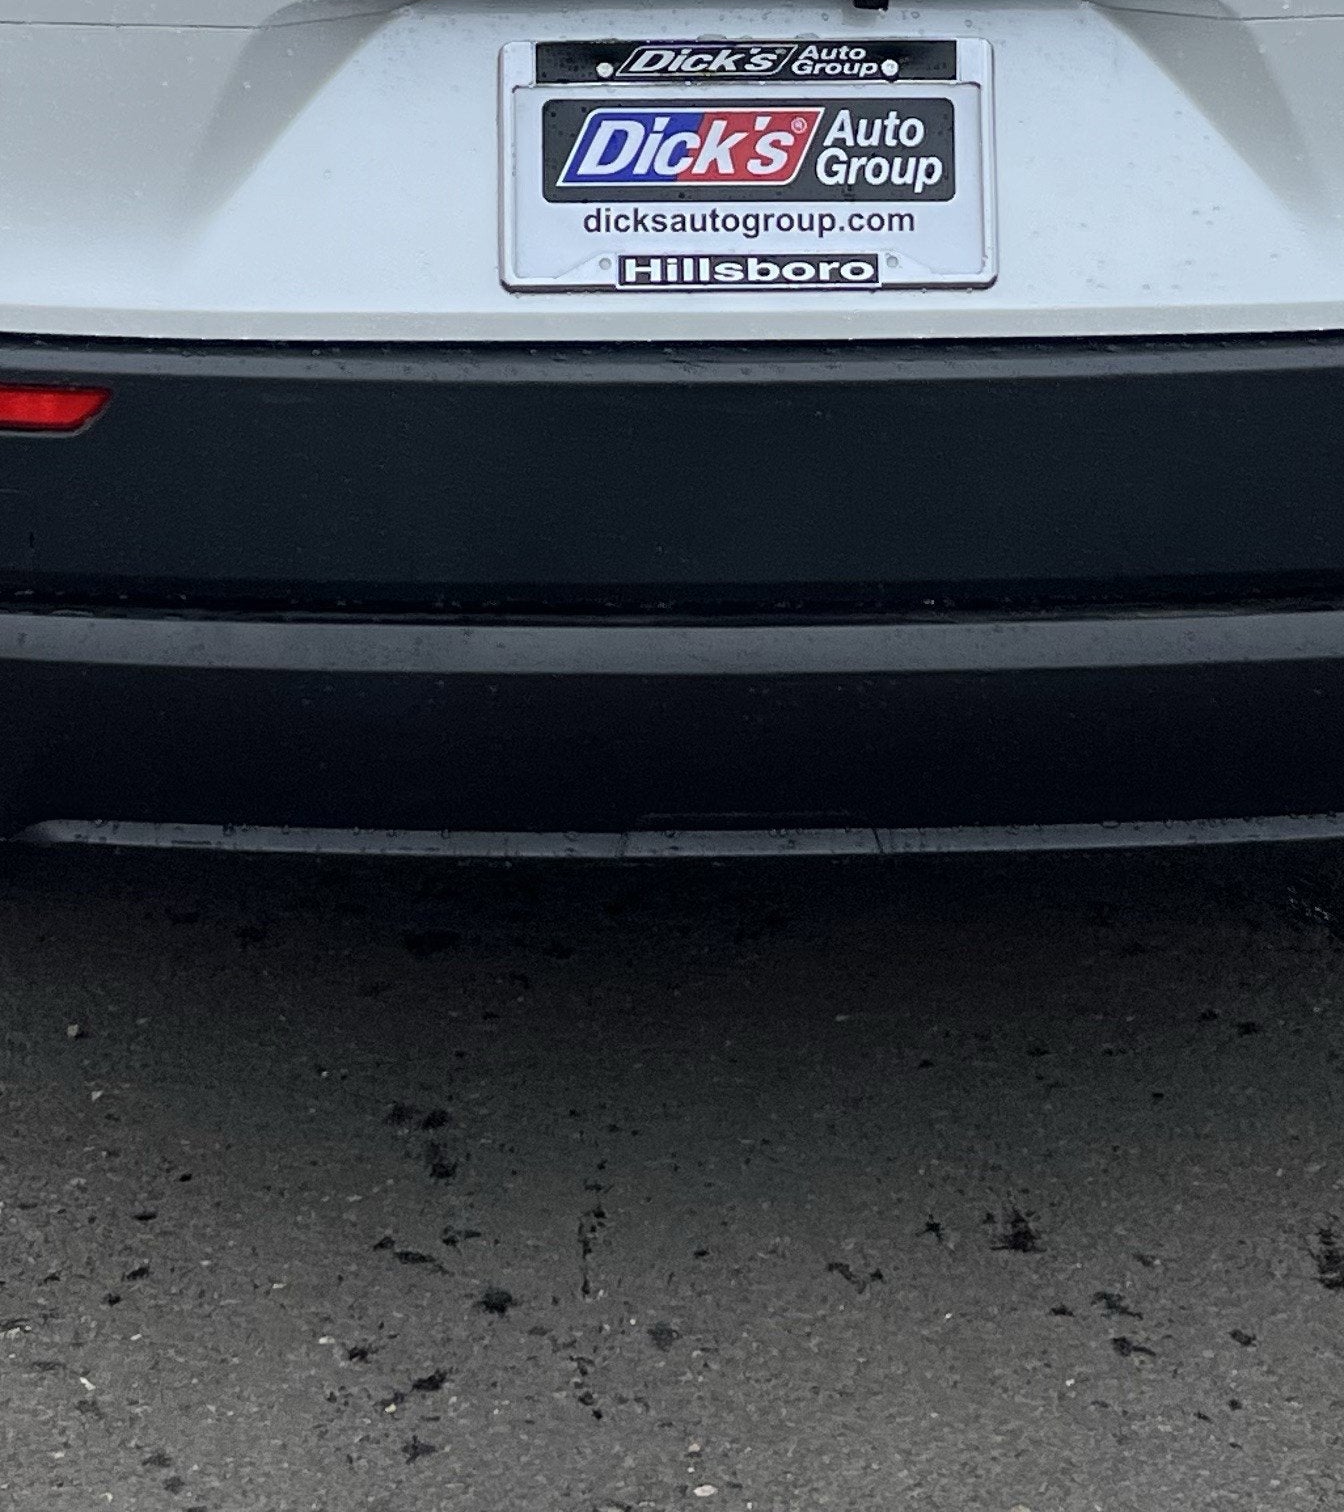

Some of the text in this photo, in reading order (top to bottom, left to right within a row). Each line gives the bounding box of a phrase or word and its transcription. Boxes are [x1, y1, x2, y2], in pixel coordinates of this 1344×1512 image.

[629, 46, 779, 74] Dick's
[792, 59, 878, 76] Group
[799, 45, 867, 61] Auto
[824, 109, 925, 148] Auto
[576, 115, 792, 177] Dick's
[815, 148, 943, 193] Group
[583, 207, 916, 238] dicksautogroup.com
[624, 256, 876, 284] Hillsboro
